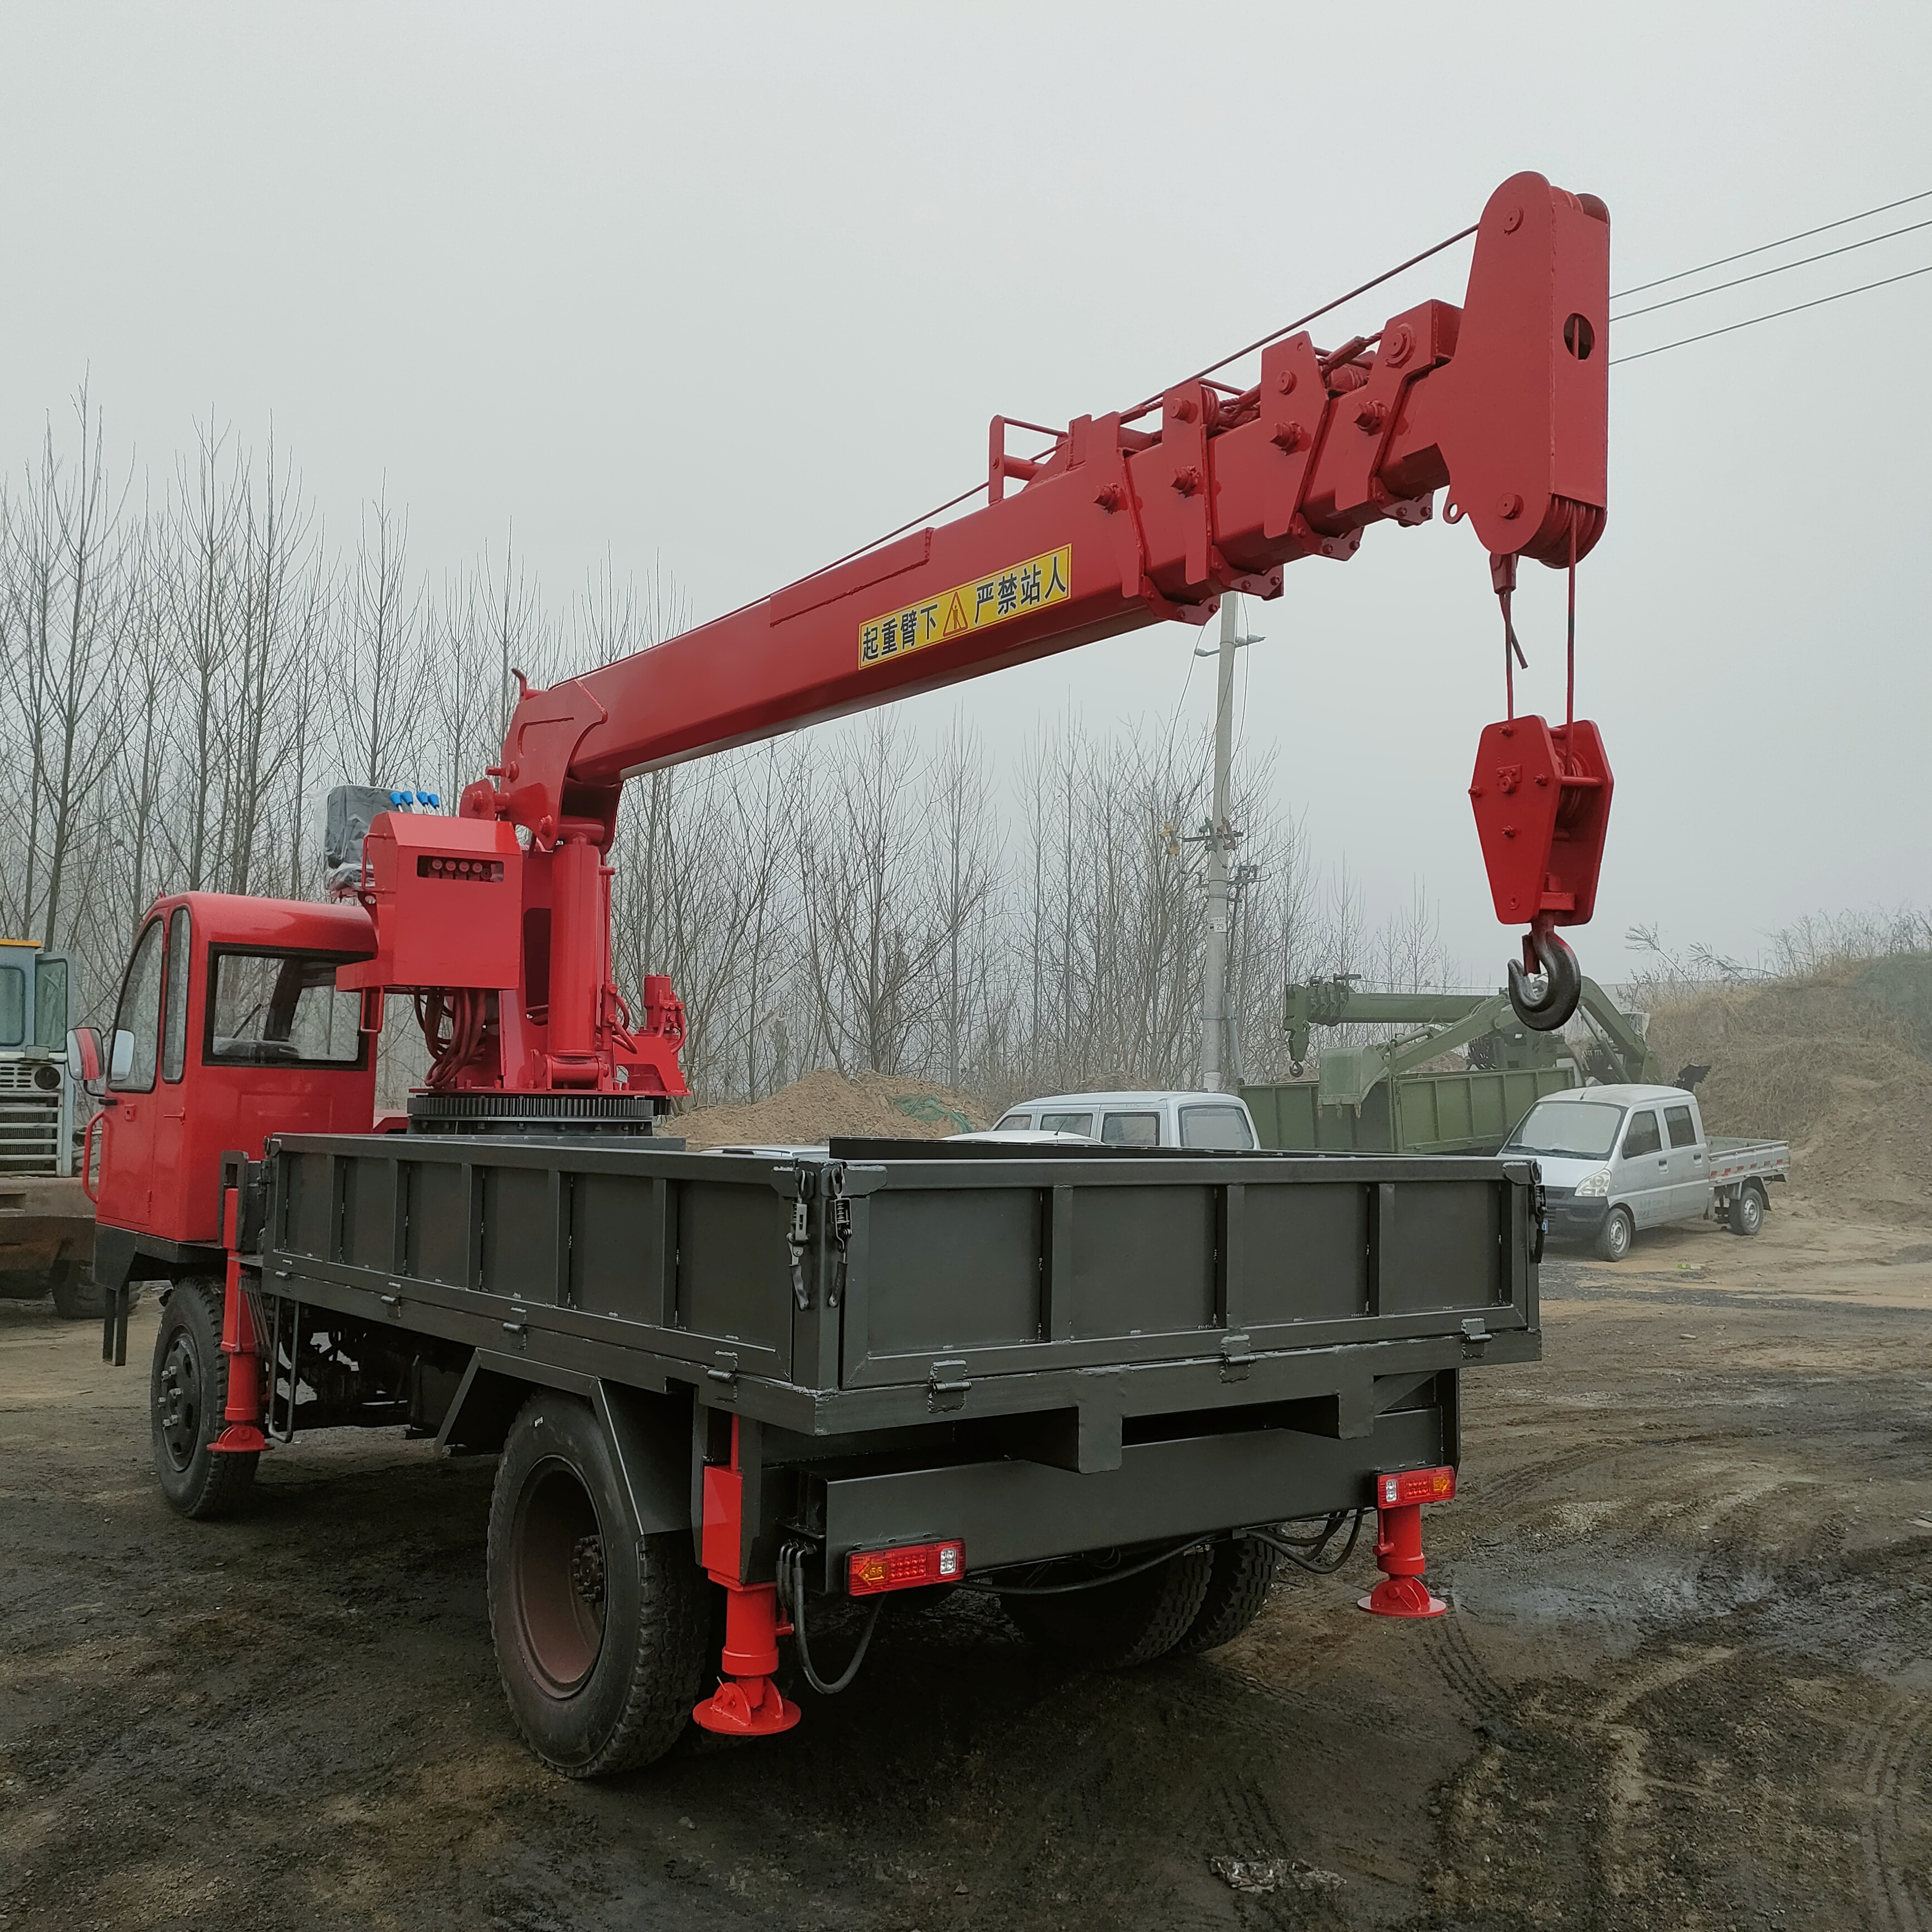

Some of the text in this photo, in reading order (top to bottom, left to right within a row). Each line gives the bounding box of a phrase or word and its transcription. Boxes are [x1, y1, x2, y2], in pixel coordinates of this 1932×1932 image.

[862, 555, 1066, 662] 起重臂下 严禁站人
